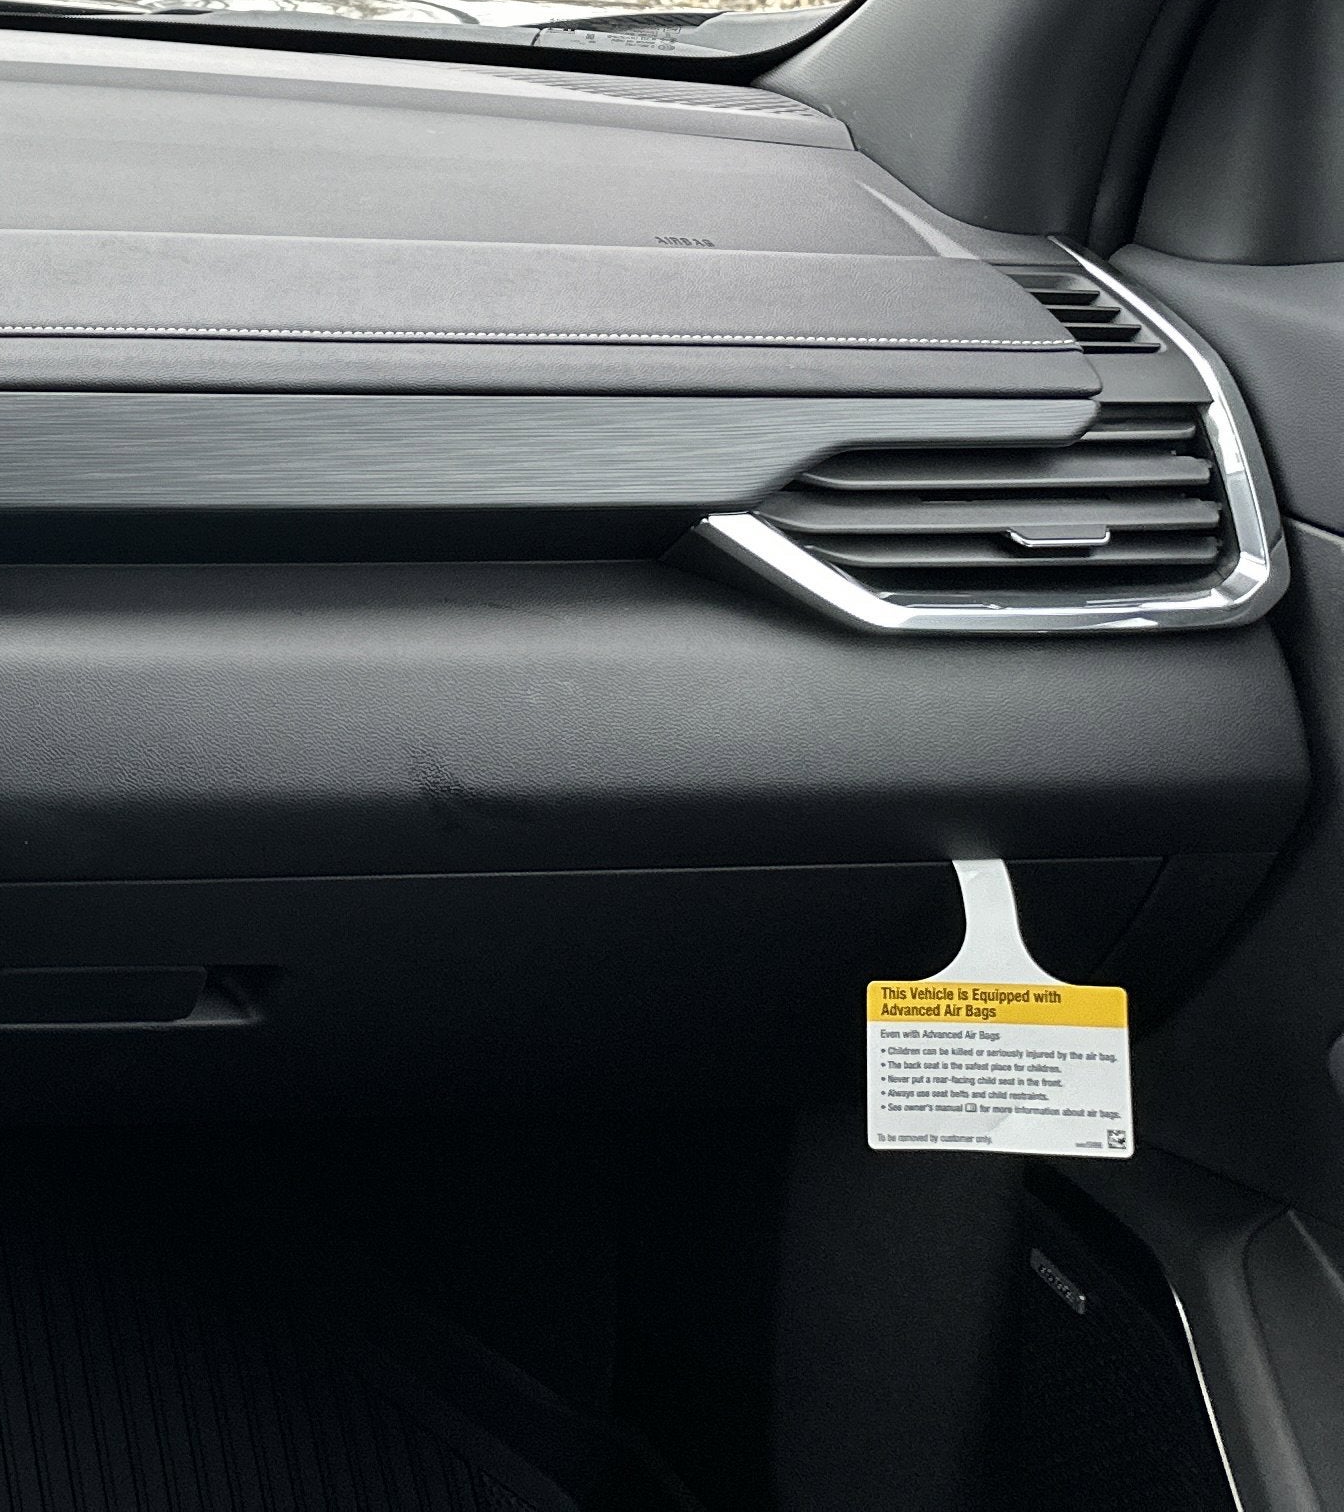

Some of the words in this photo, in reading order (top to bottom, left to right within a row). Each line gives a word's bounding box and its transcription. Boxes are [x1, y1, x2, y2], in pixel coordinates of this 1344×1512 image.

[880, 987, 907, 1000] This
[909, 987, 954, 1001] Vehicle
[958, 988, 969, 1001] is
[972, 988, 1030, 1004] Equipped
[1033, 990, 1061, 1004] with
[880, 1003, 941, 1017] Advanced
[944, 1004, 963, 1017] Air
[965, 1004, 997, 1020] Bags
[880, 1029, 900, 1039] Even
[902, 1029, 920, 1038] with
[922, 1030, 963, 1039] Advanced
[965, 1030, 977, 1039] Air
[979, 1031, 1000, 1042] Bags
[888, 1047, 920, 1056] Children
[922, 1048, 937, 1056] can
[939, 1047, 949, 1056] be
[952, 1047, 973, 1056] killed
[976, 1049, 985, 1057] or
[1025, 1050, 1055, 1059] injured
[1057, 1050, 1067, 1061] by
[1069, 1051, 1083, 1060] the
[1086, 1052, 1098, 1060] air
[888, 1075, 910, 1083] Never
[912, 1075, 924, 1084] put
[977, 1076, 996, 1085] child
